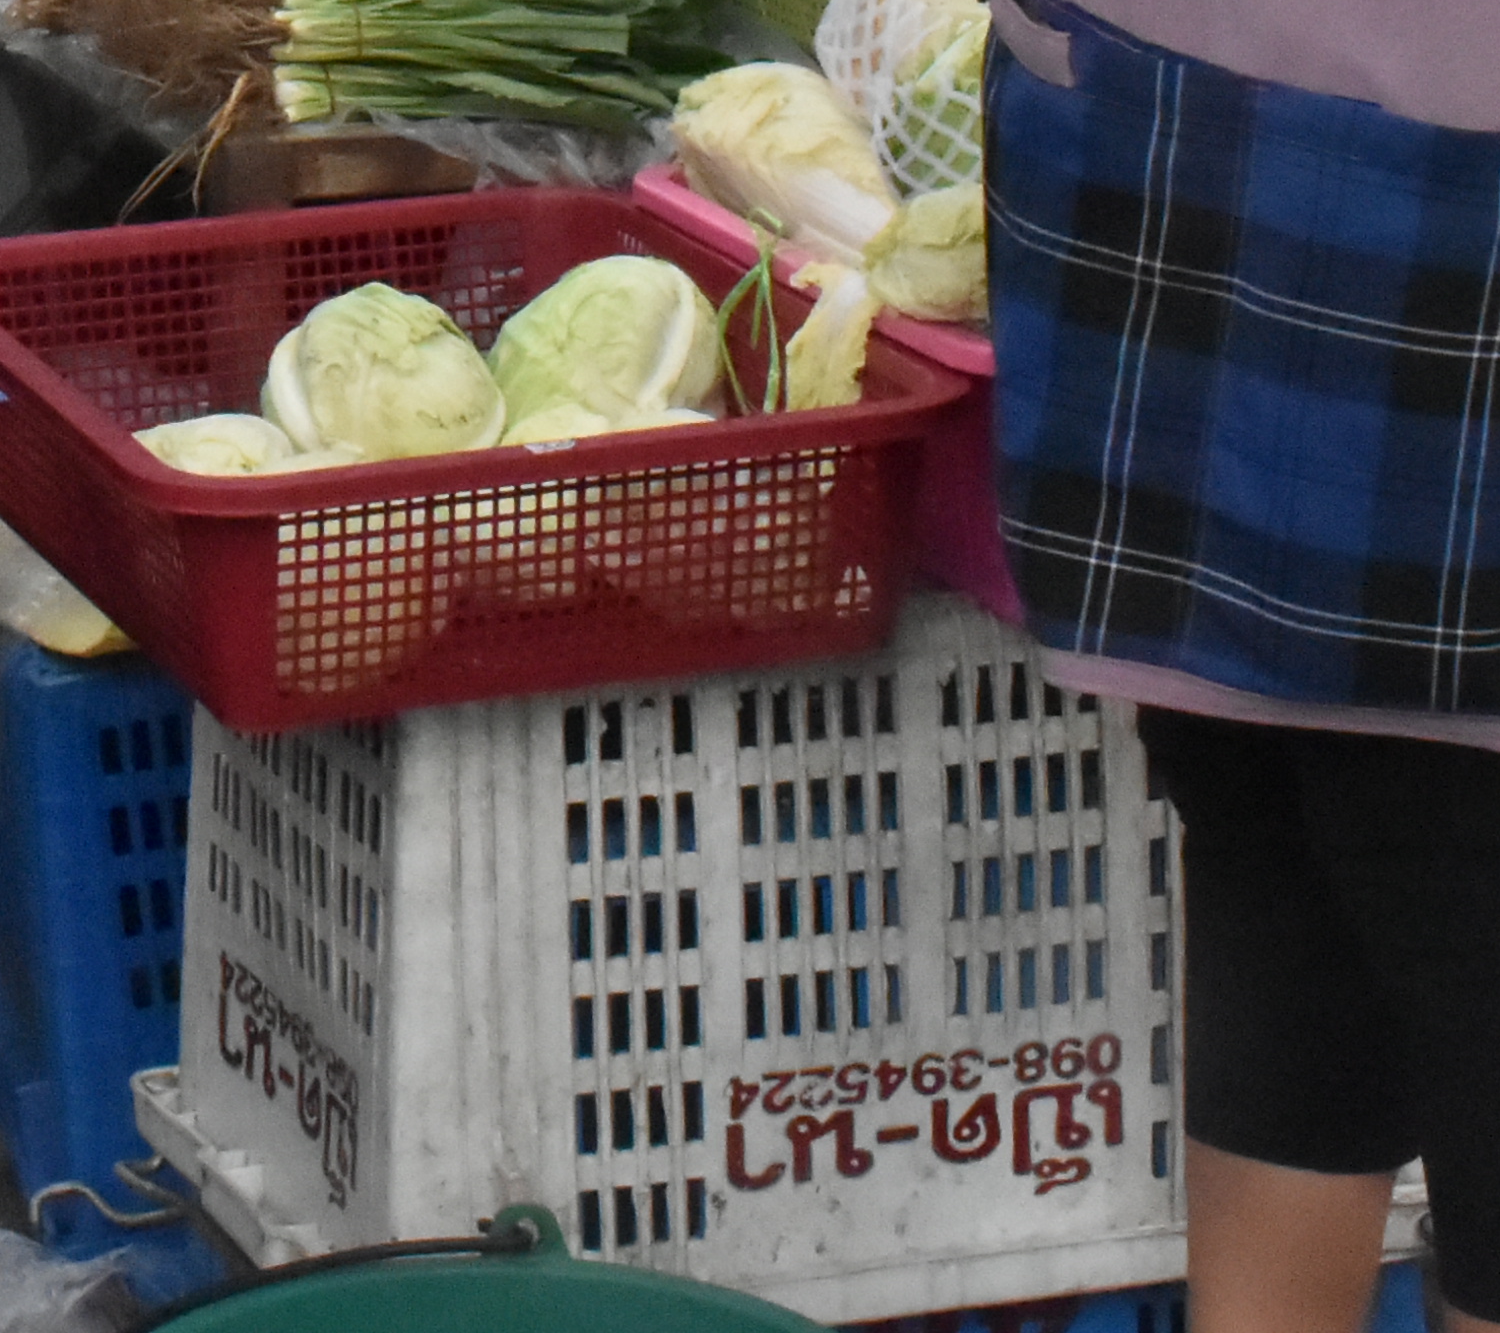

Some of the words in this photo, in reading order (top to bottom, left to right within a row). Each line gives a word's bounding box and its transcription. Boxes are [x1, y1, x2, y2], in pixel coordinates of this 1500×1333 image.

[728, 1032, 1122, 1123] 098-3945224
[726, 1078, 1122, 1196] เป็ด-นา
